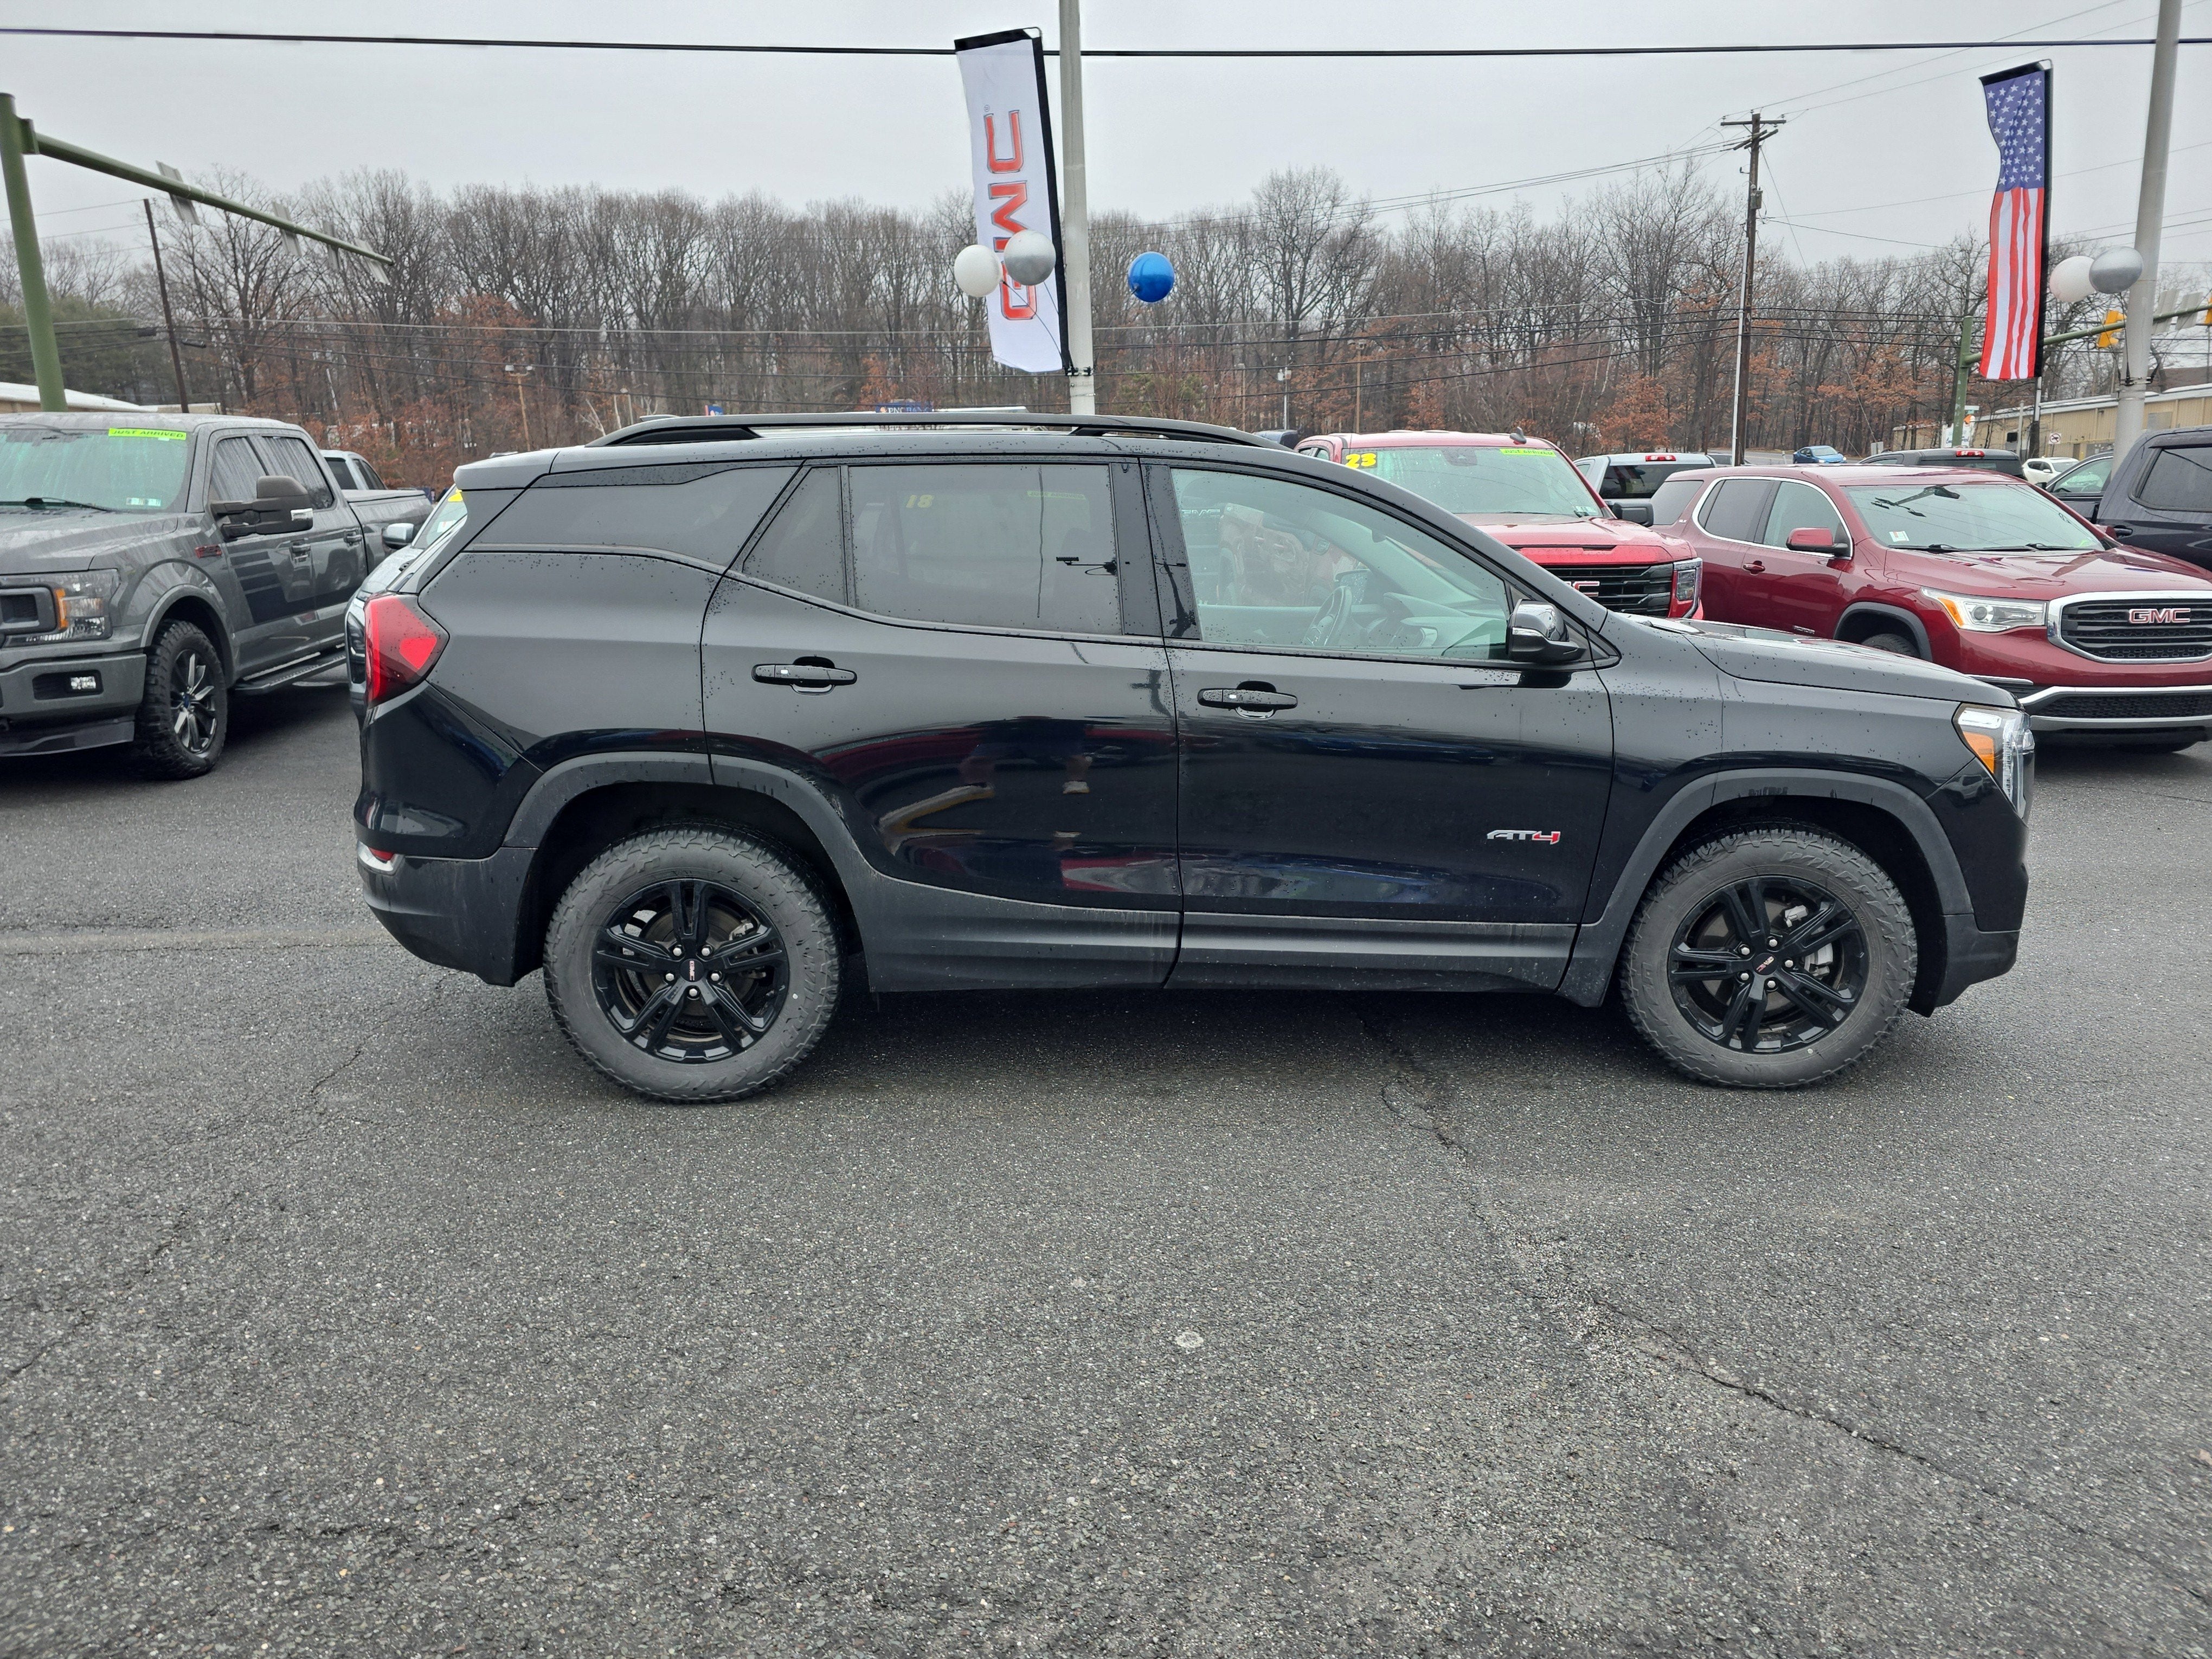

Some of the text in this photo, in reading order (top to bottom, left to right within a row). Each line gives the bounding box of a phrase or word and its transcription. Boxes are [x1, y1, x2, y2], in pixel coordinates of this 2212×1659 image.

[1345, 453, 1377, 470] 23
[2129, 608, 2191, 623] GMC
[1487, 829, 1561, 845] AT4
